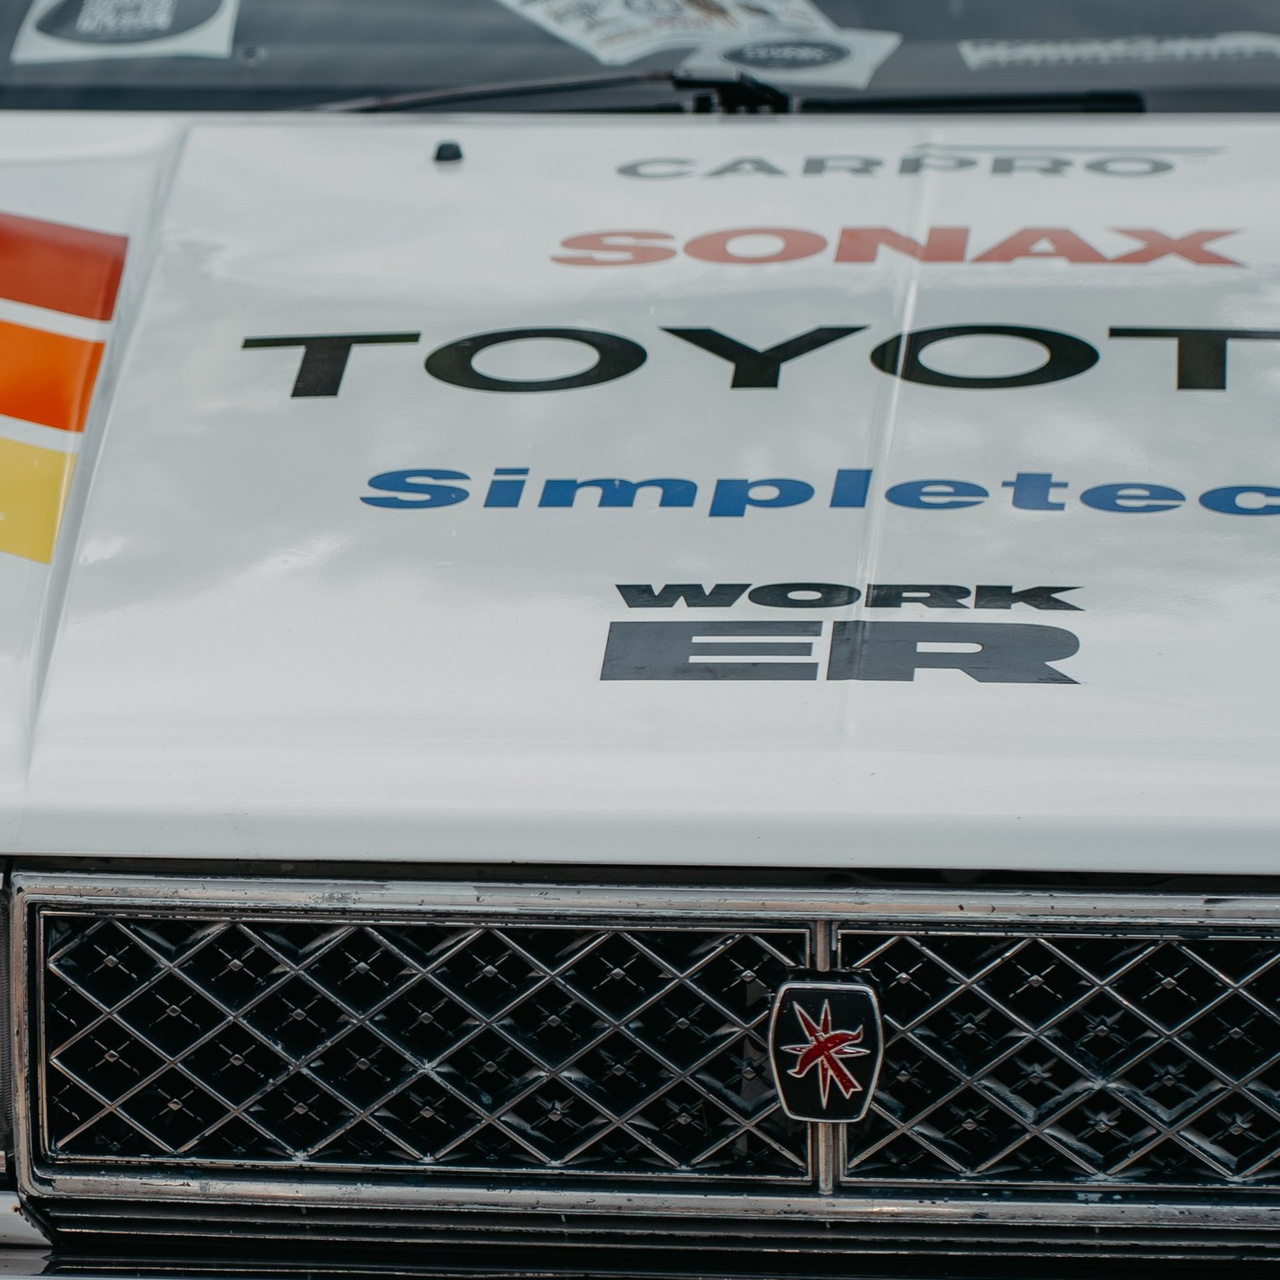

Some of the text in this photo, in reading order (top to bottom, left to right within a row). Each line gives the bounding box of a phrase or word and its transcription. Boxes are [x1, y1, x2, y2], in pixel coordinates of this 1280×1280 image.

[616, 154, 1175, 179] CARPRO
[550, 226, 1246, 268] SONAX
[241, 324, 1280, 398] TOYOT
[360, 467, 1280, 518] Simpletec
[615, 582, 1085, 612] WORK
[599, 620, 1082, 685] ER
